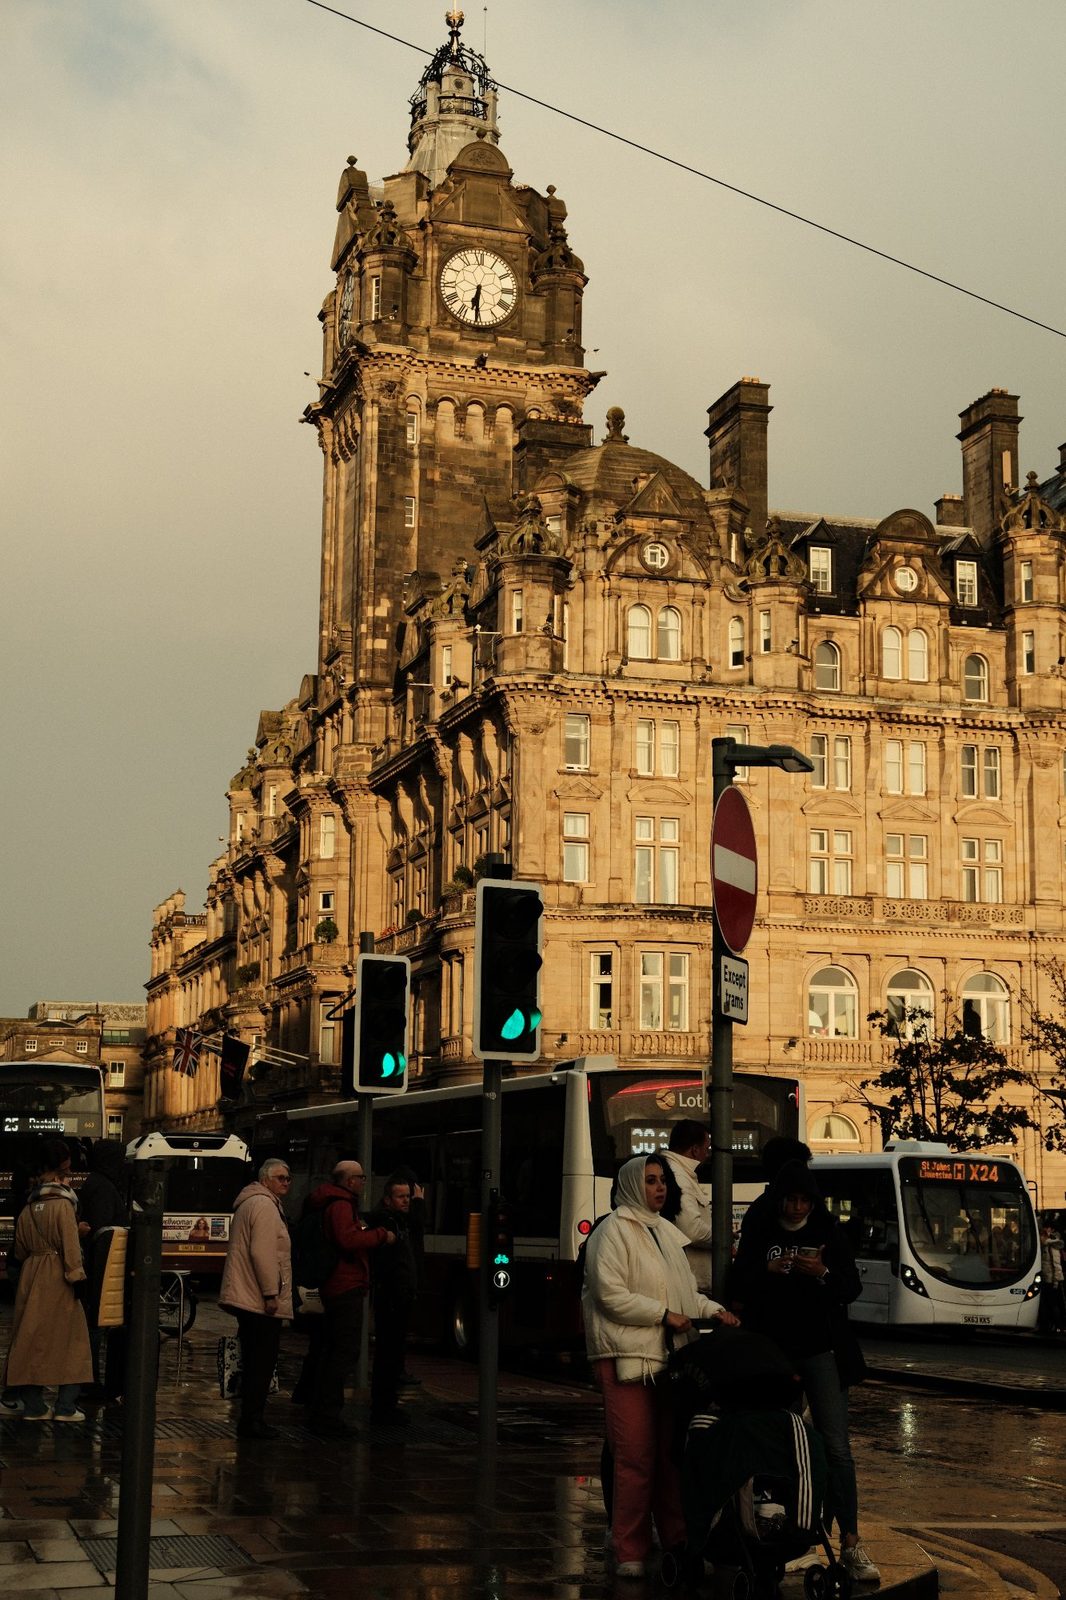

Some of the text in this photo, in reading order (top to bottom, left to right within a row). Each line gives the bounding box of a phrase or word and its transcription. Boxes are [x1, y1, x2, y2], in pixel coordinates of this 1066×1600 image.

[723, 964, 746, 990] Except
[725, 988, 744, 1010] trams
[4, 1117, 19, 1132] 25
[193, 1156, 198, 1169] 1
[921, 1161, 951, 1171] St Johns
[968, 1163, 999, 1183] X24
